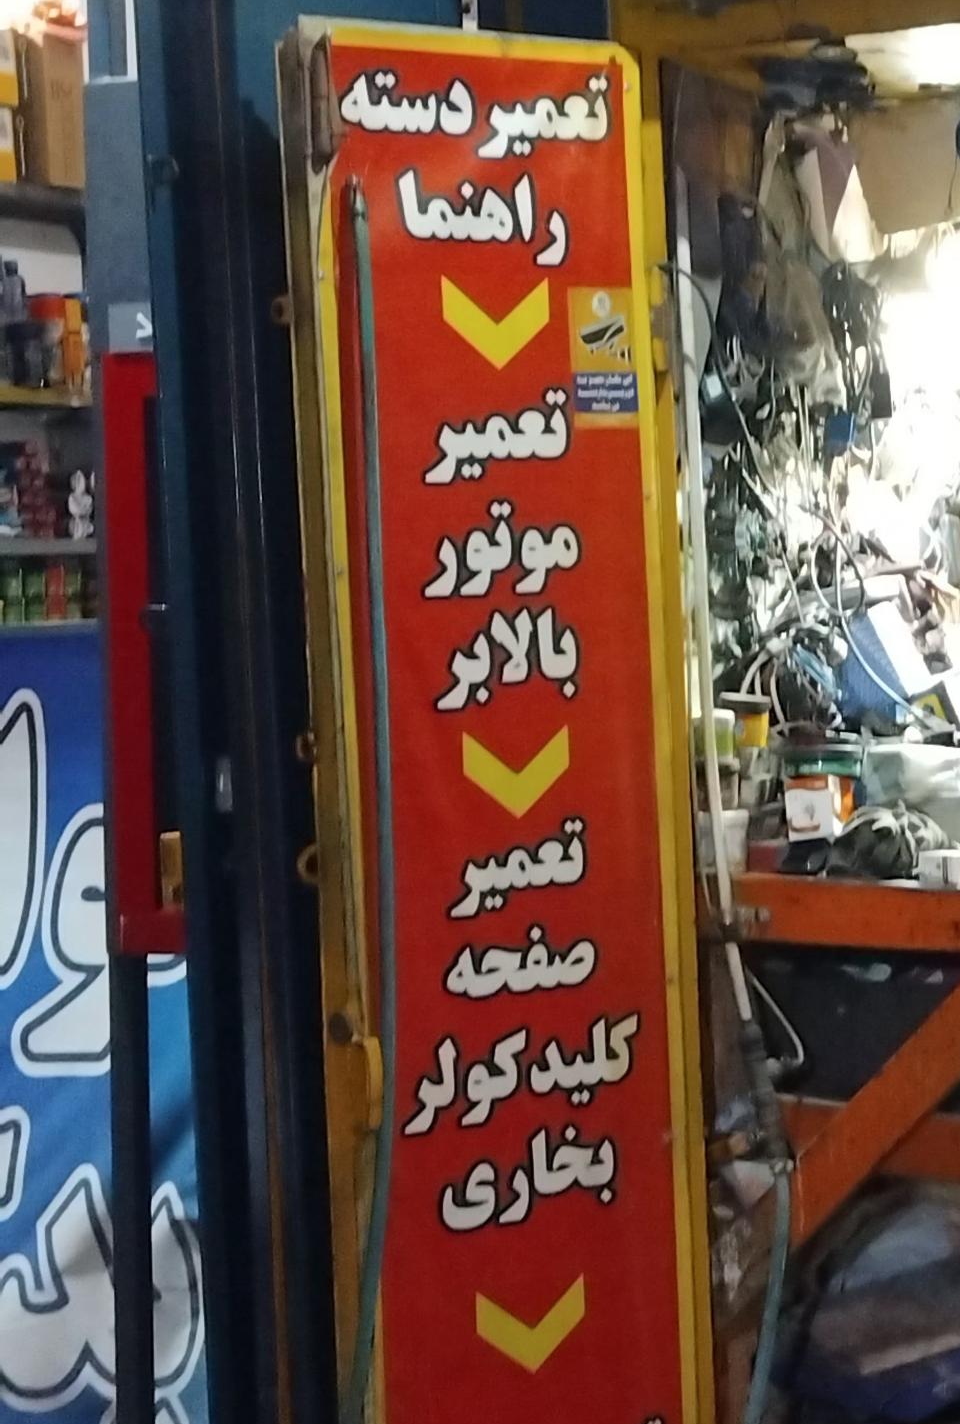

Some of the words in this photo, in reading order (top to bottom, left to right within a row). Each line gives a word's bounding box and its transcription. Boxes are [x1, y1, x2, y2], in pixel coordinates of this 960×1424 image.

[340, 71, 474, 136] دسته
[475, 74, 609, 159] تعمیر
[398, 168, 567, 266] راهنما
[424, 388, 568, 484] تعمیر
[424, 501, 579, 598] موتور
[437, 607, 578, 709] بالابر
[449, 818, 585, 918] تعمیر
[445, 926, 596, 999] صفحه
[403, 1030, 528, 1136] کولر
[529, 1014, 640, 1105] کلید
[442, 1125, 615, 1230] بخاری
